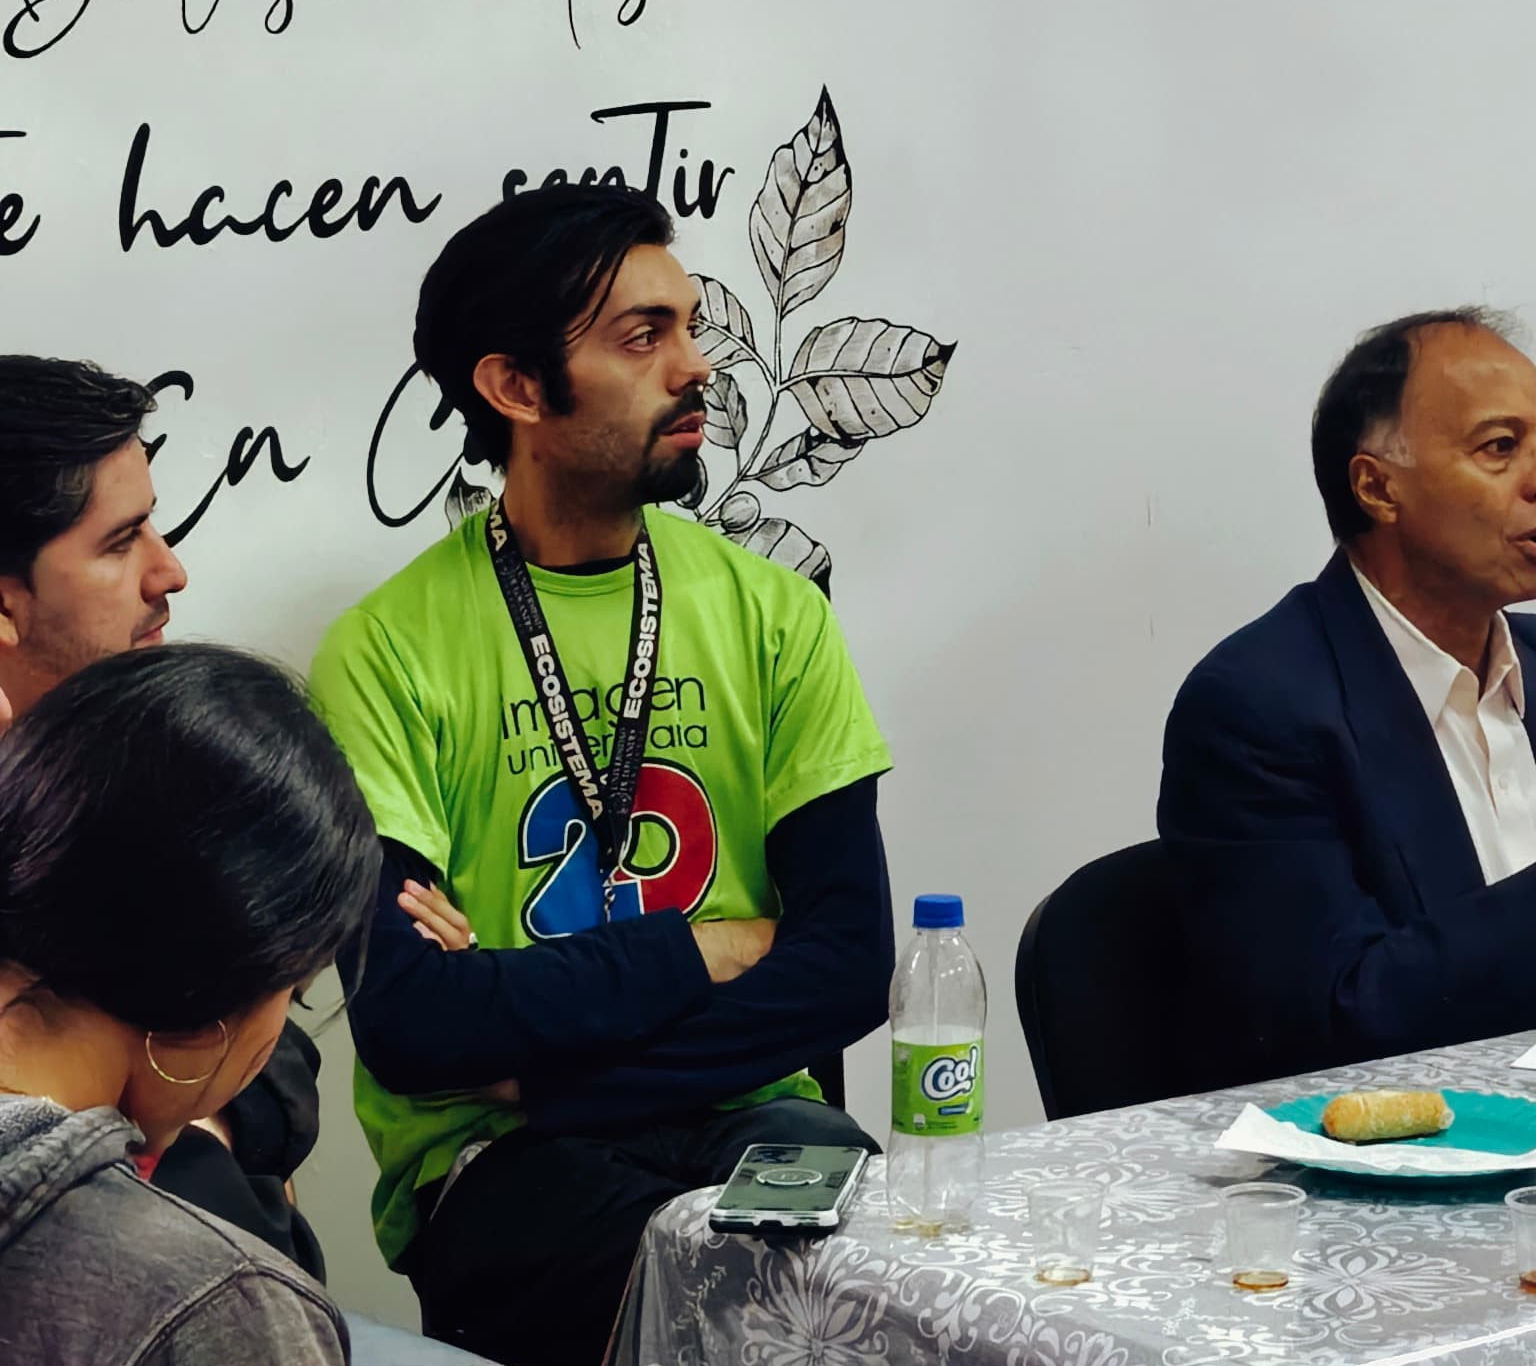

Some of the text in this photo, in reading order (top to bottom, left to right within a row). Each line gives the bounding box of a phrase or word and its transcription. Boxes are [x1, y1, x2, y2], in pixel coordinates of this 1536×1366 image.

[119, 123, 442, 252] hacen
[623, 542, 659, 720] ECOSISTEMA
[529, 633, 605, 821] ECOSISTEMA
[920, 1044, 978, 1101] Cool
